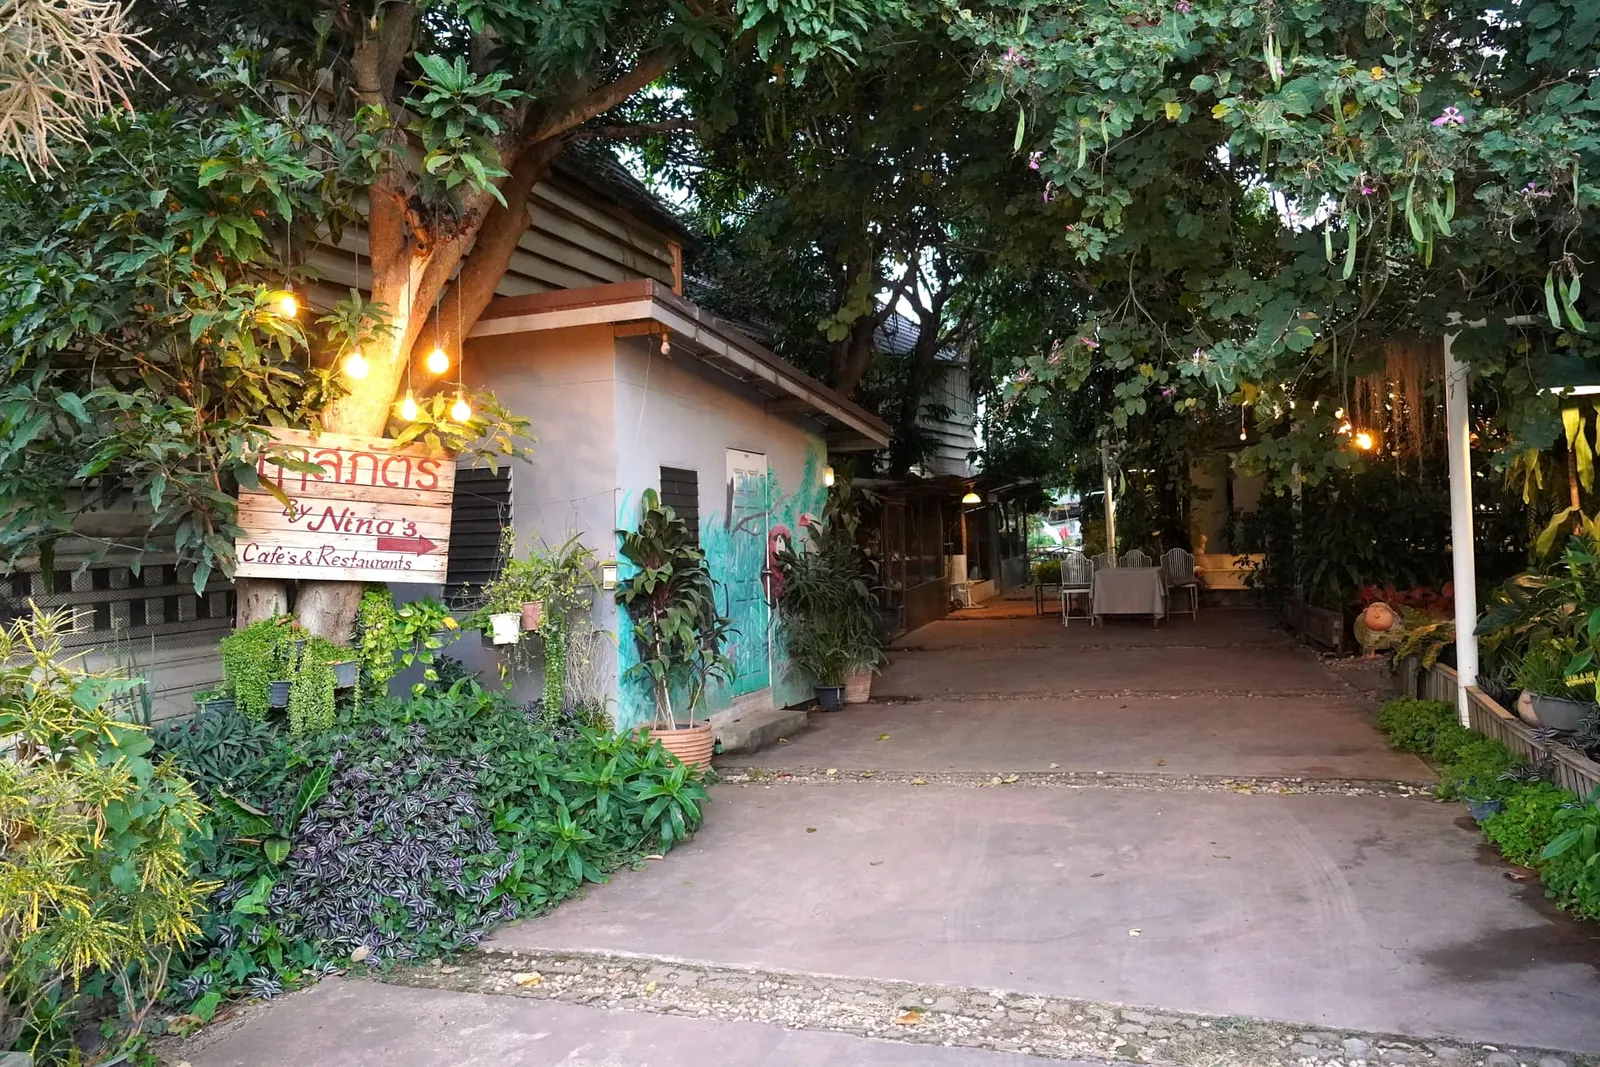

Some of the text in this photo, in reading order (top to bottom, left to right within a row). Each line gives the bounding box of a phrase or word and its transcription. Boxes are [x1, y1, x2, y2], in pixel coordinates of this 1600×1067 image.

[282, 498, 418, 537] By Nina's
[316, 544, 413, 570] Restaurants
